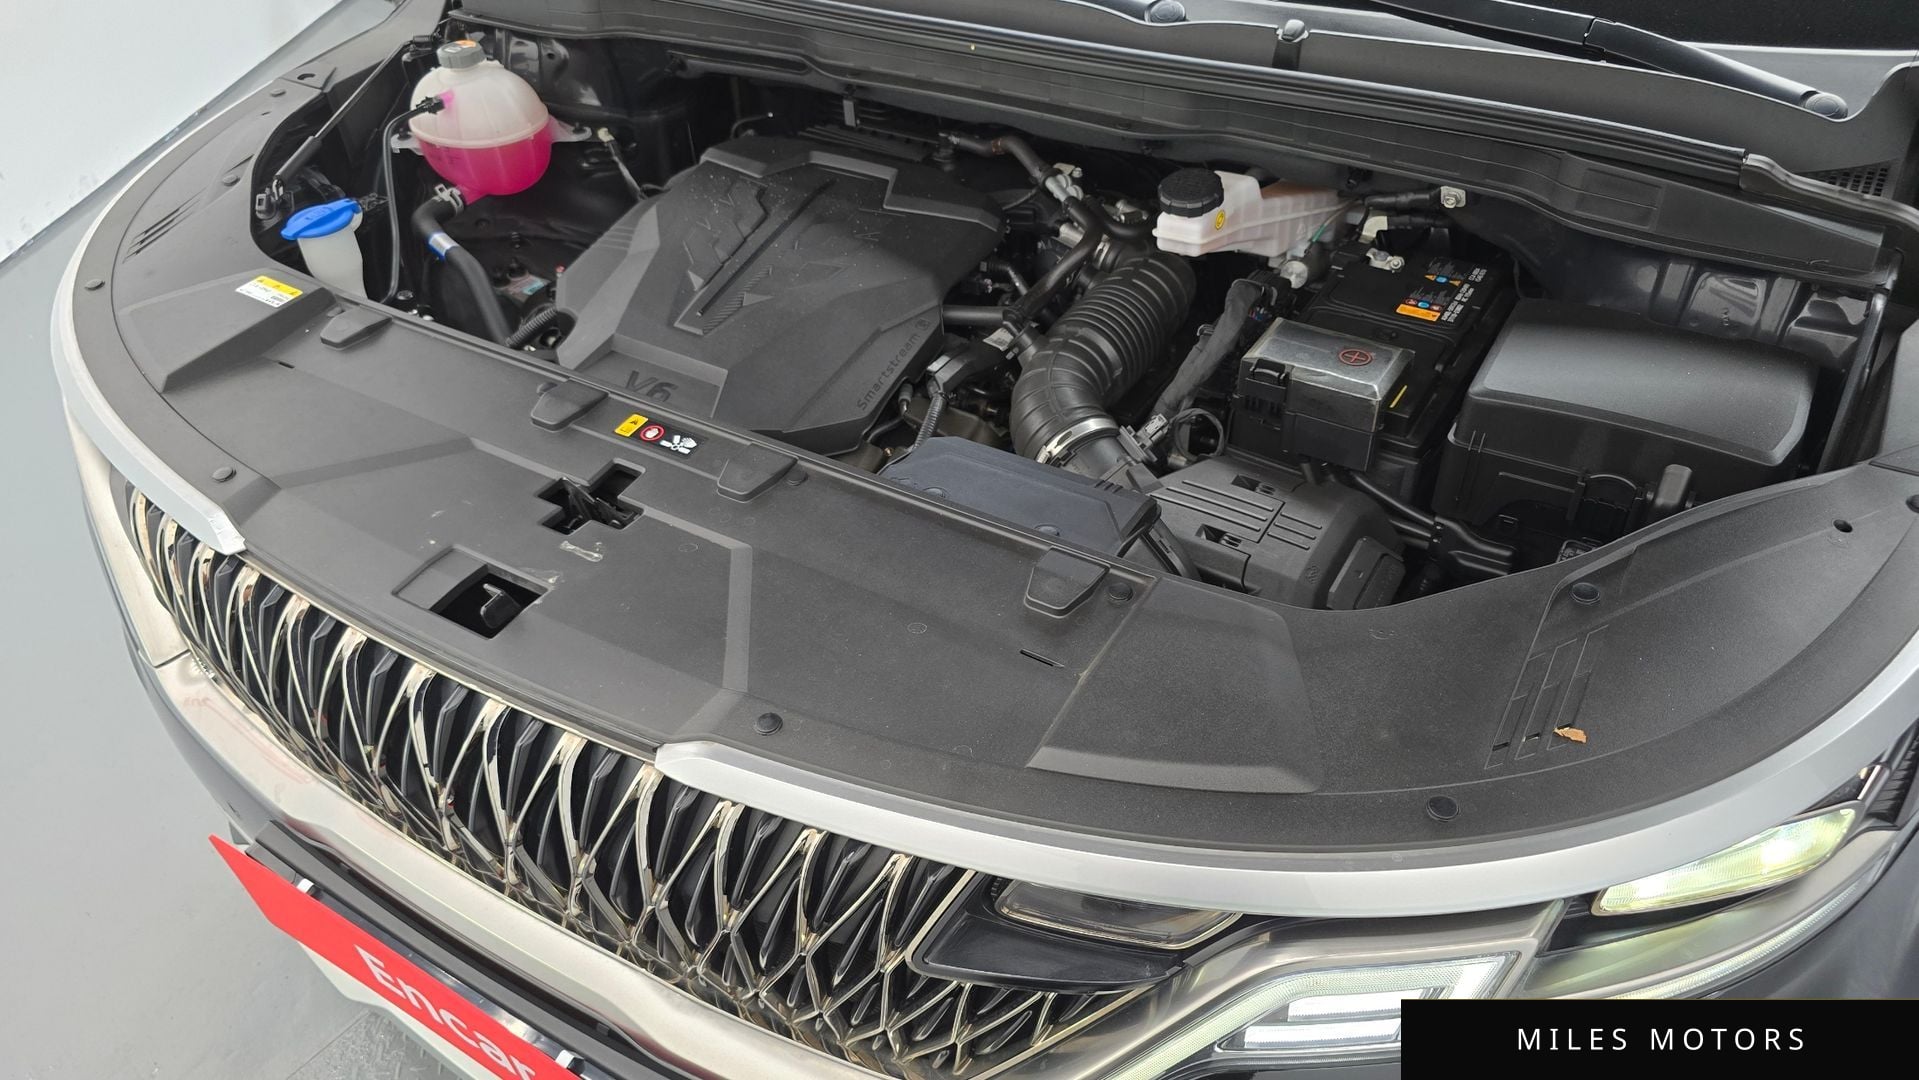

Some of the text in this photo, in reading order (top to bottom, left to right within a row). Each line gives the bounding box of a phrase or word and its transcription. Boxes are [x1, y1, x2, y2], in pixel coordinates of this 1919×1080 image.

[626, 370, 679, 402] V6
[857, 333, 920, 411] Smartstream
[354, 943, 536, 1080] Encar
